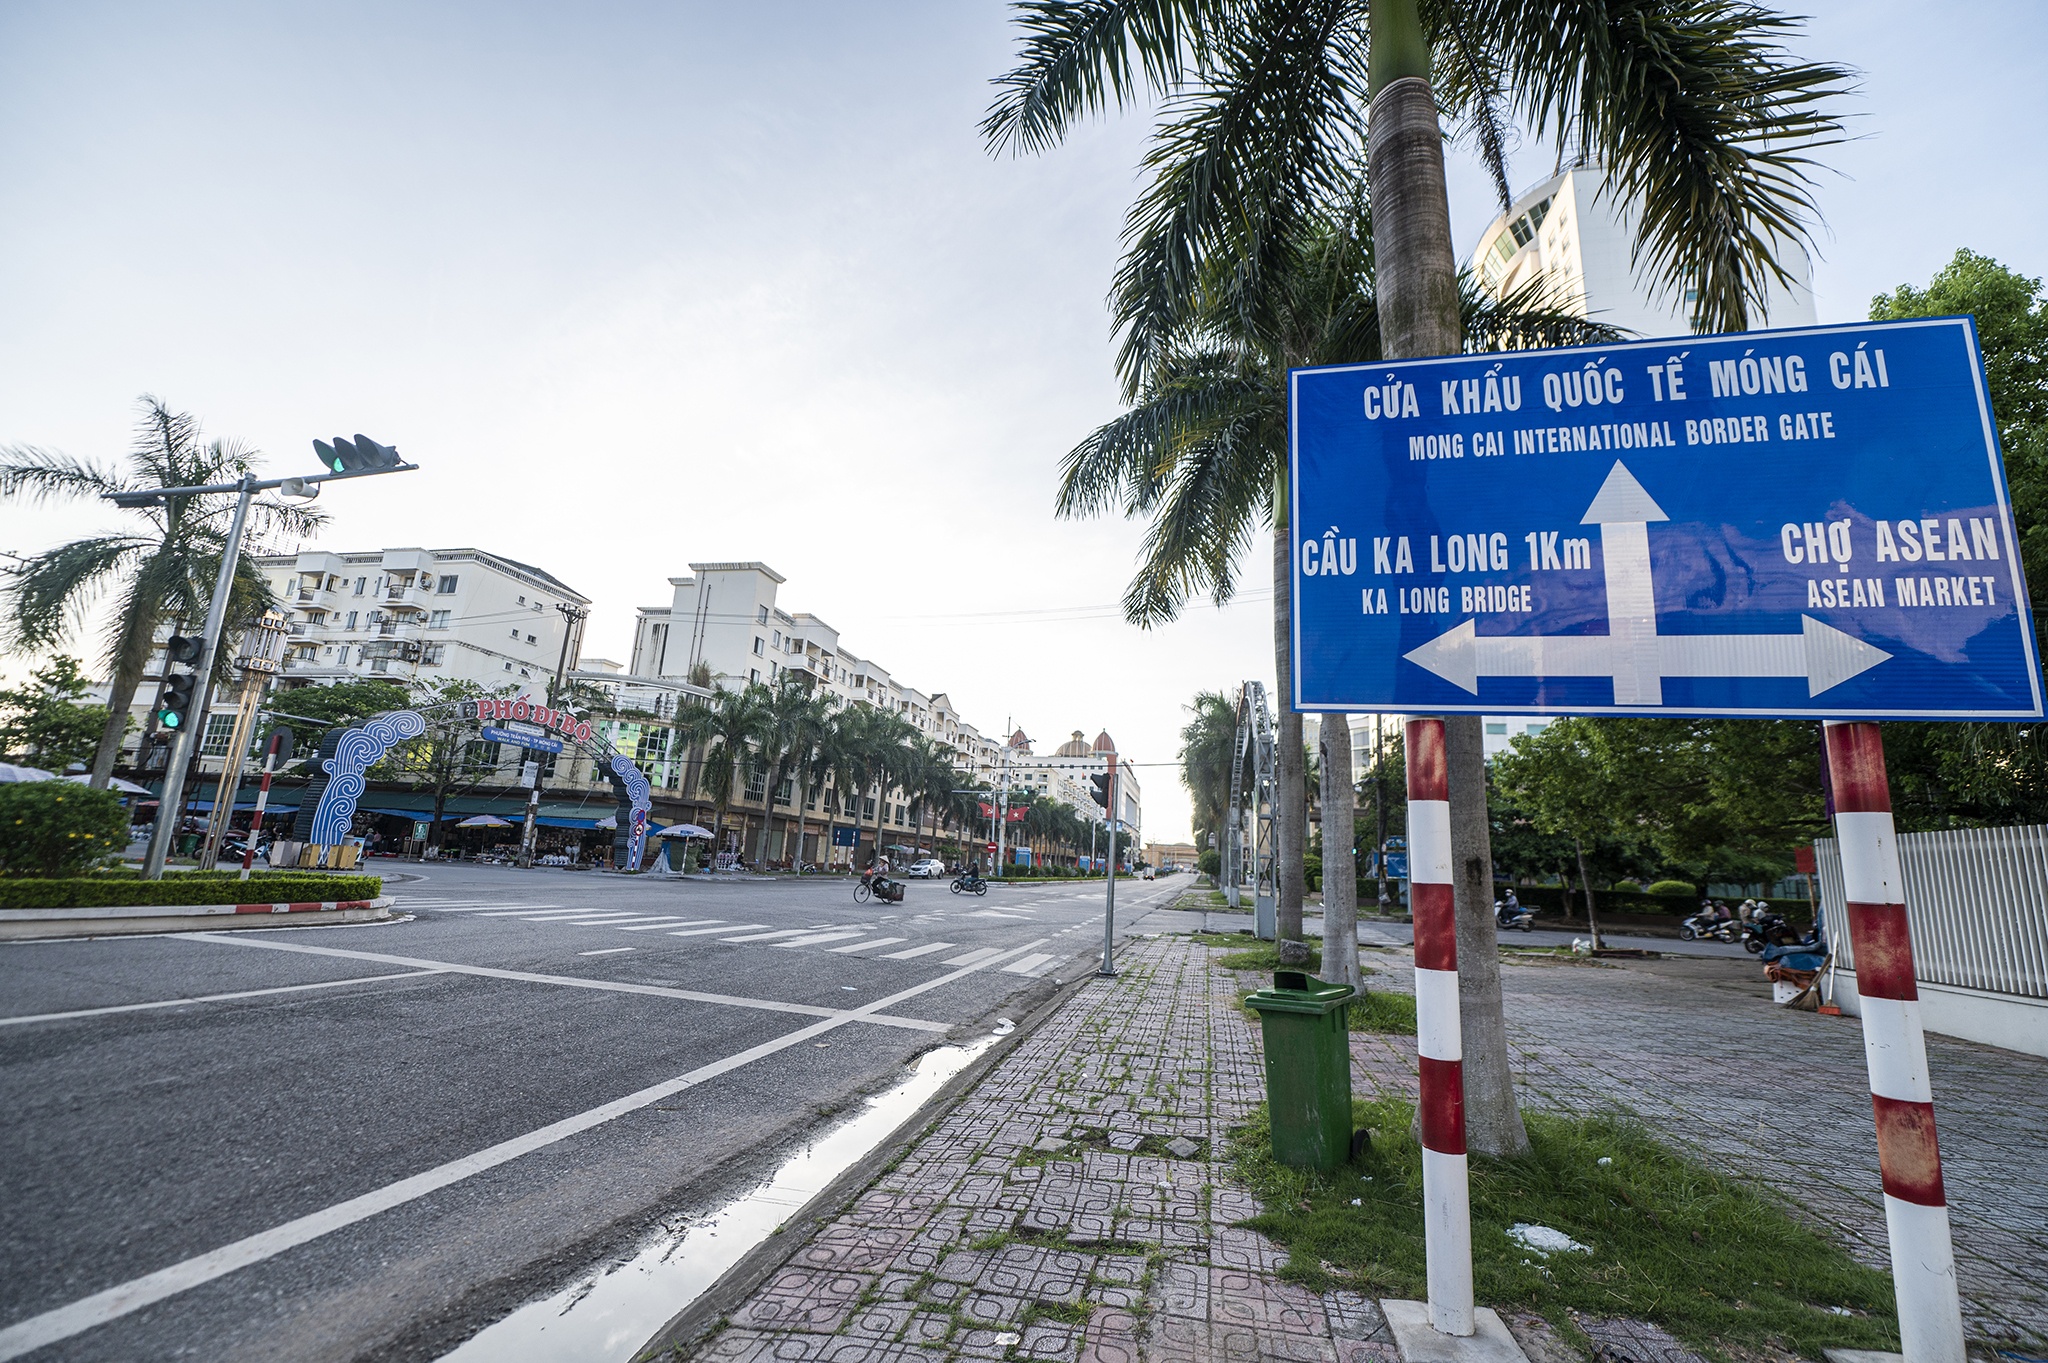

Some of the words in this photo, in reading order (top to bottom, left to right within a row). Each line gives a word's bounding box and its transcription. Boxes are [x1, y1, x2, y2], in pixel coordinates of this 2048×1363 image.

[1364, 373, 1420, 420] CỬA
[1441, 363, 1521, 415] KHẨU
[1543, 356, 1624, 413] QUỐC
[1647, 351, 1690, 402] TẾ
[1709, 349, 1807, 397] MÓNG
[1830, 342, 1889, 389] CÁI
[1409, 434, 1463, 460] MONG
[1473, 432, 1504, 457] CAI
[1514, 422, 1675, 454] INTERNATIONAL
[1686, 416, 1768, 445] BORDER
[1780, 412, 1835, 440] GATE
[1303, 526, 1356, 576] CẦU
[1374, 537, 1413, 574] KA
[1431, 533, 1508, 572] LONG
[1525, 532, 1591, 570] 1Km
[1781, 518, 1852, 573] CHỢ
[1876, 518, 1999, 562] ASEAN
[1363, 589, 1388, 614] KA
[1400, 587, 1449, 613] LONG
[1462, 585, 1532, 612] BRIDGE
[1808, 578, 1885, 608] ASEAN
[1895, 576, 1995, 606] MARKET
[477, 694, 530, 720] PHỐ
[532, 704, 560, 728] ĐI
[560, 714, 591, 744] BỘ
